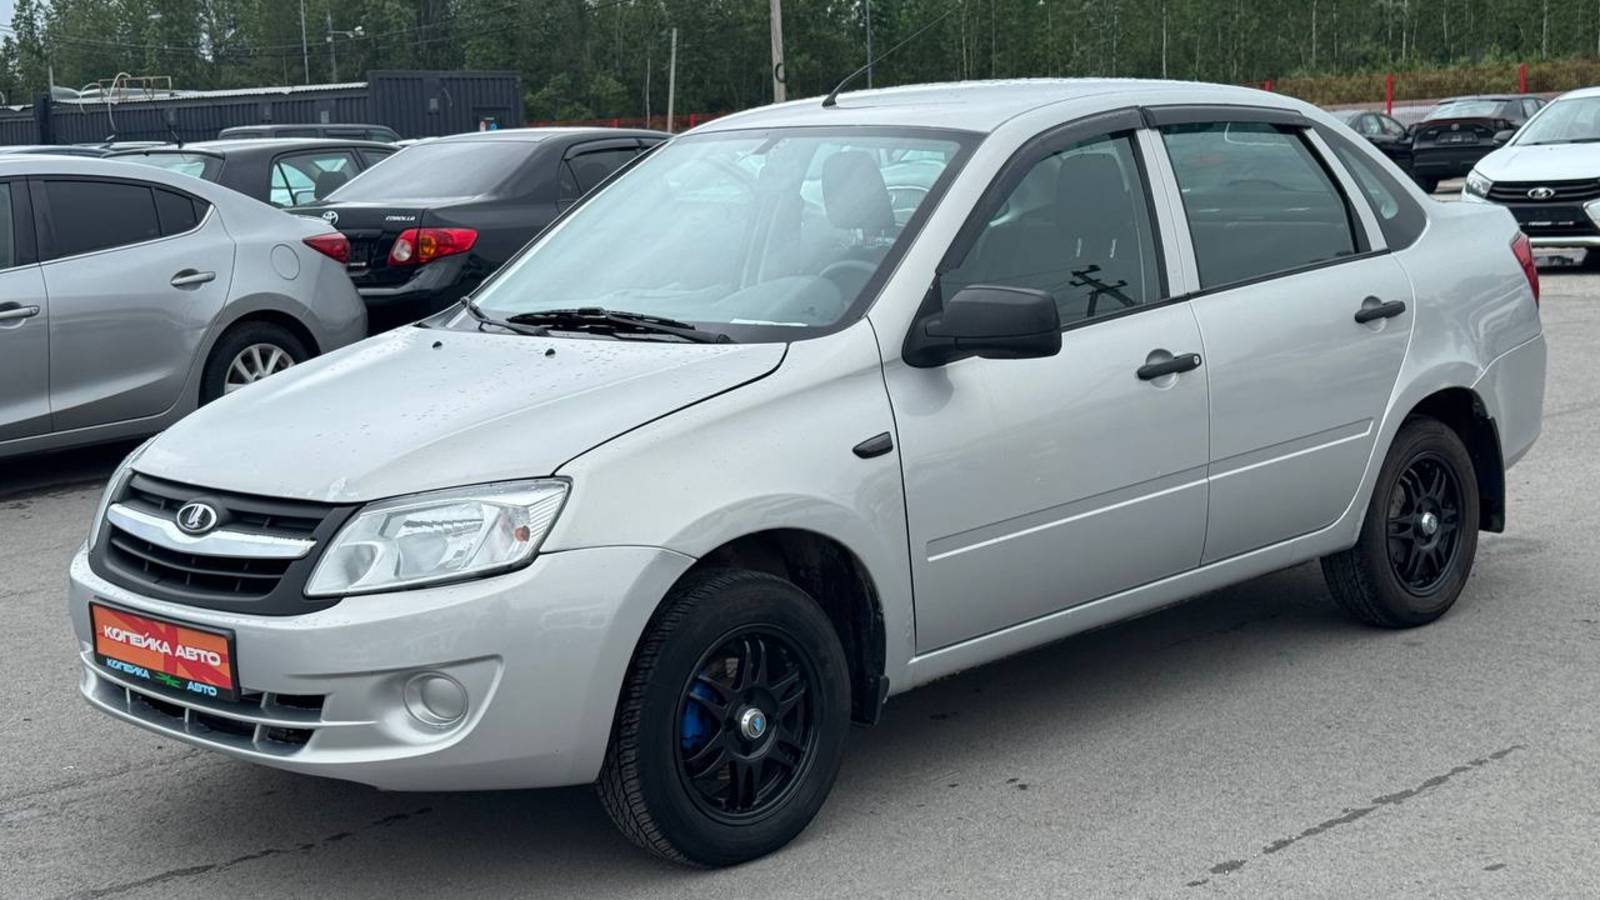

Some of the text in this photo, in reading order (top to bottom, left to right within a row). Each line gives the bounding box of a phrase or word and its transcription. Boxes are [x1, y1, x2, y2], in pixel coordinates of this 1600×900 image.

[103, 625, 221, 667] КОПЕЙКА АВТО
[187, 681, 217, 697] АВТО
